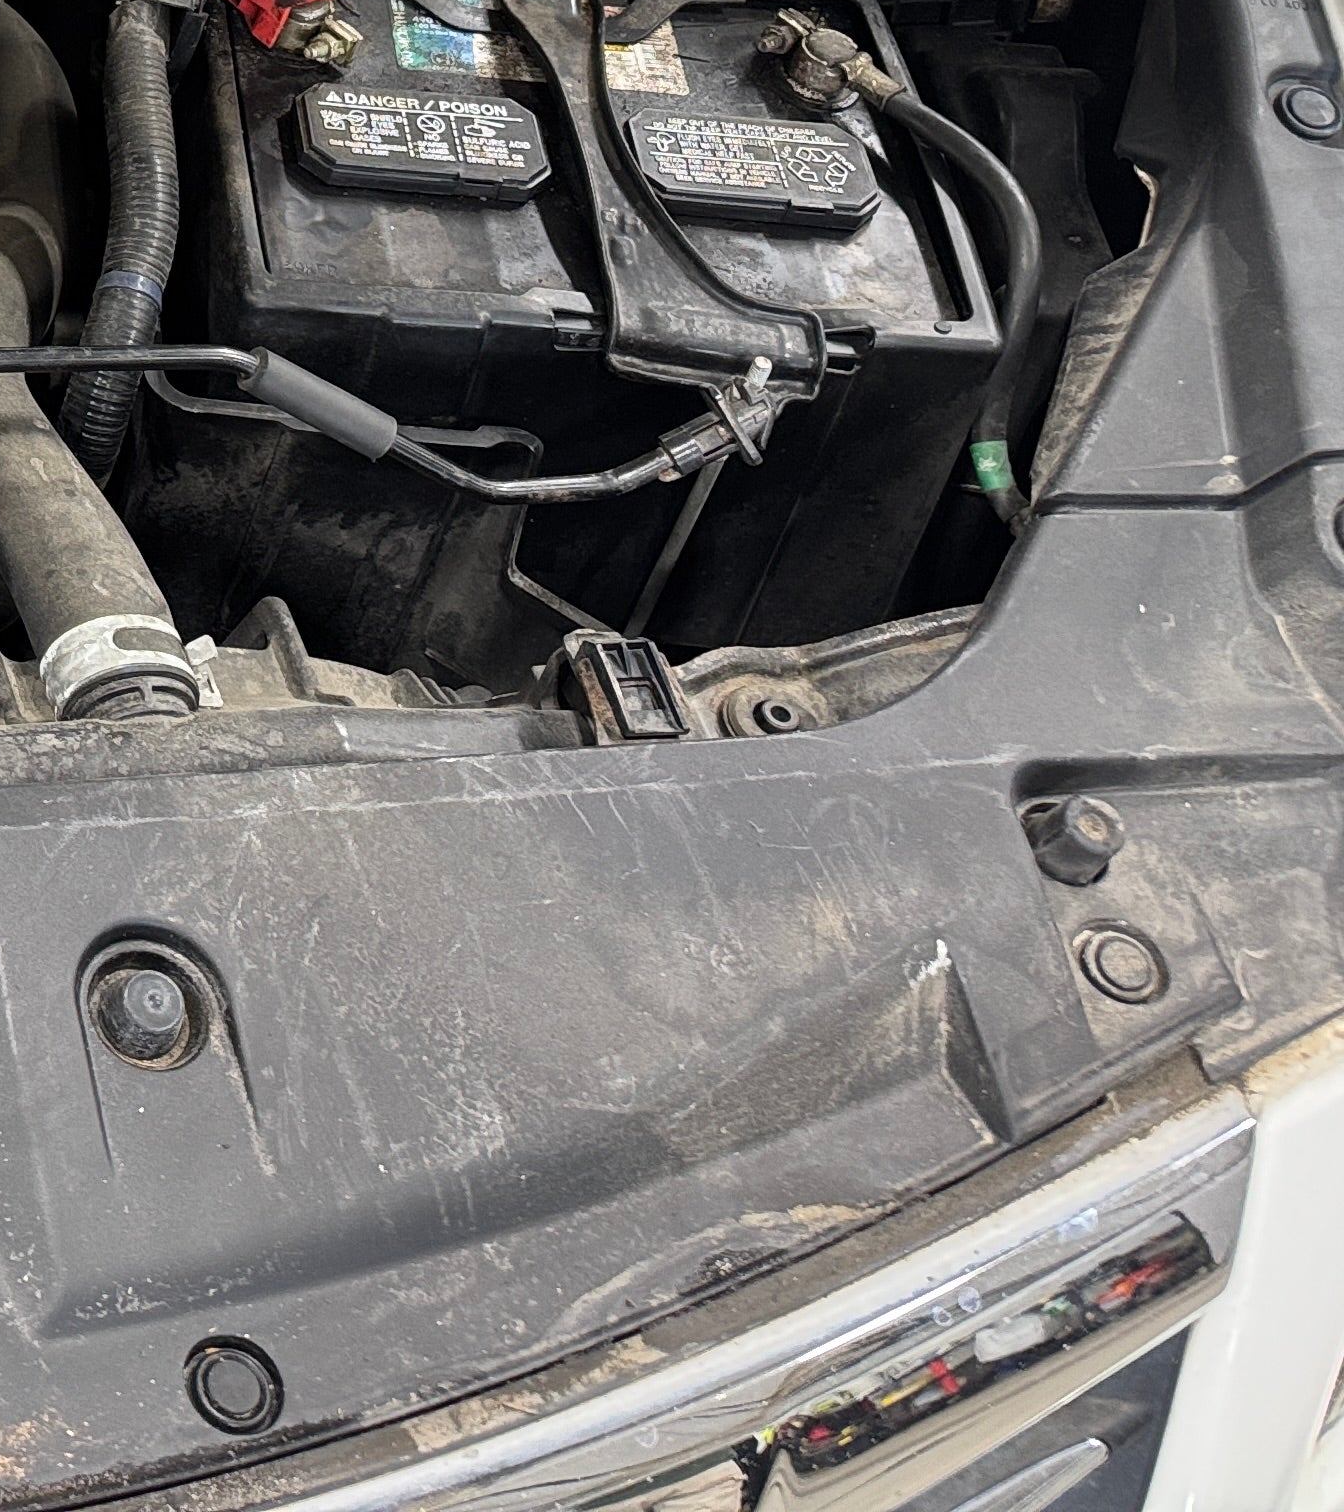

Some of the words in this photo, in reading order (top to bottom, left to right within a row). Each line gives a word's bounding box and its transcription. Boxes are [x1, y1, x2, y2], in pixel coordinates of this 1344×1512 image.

[344, 92, 420, 110] DANGER
[424, 99, 434, 111] /
[439, 101, 508, 117] POISON
[370, 113, 403, 123] SHIELD
[424, 133, 441, 141] NO
[461, 135, 507, 148] SULFURIC
[508, 140, 531, 150] ACID
